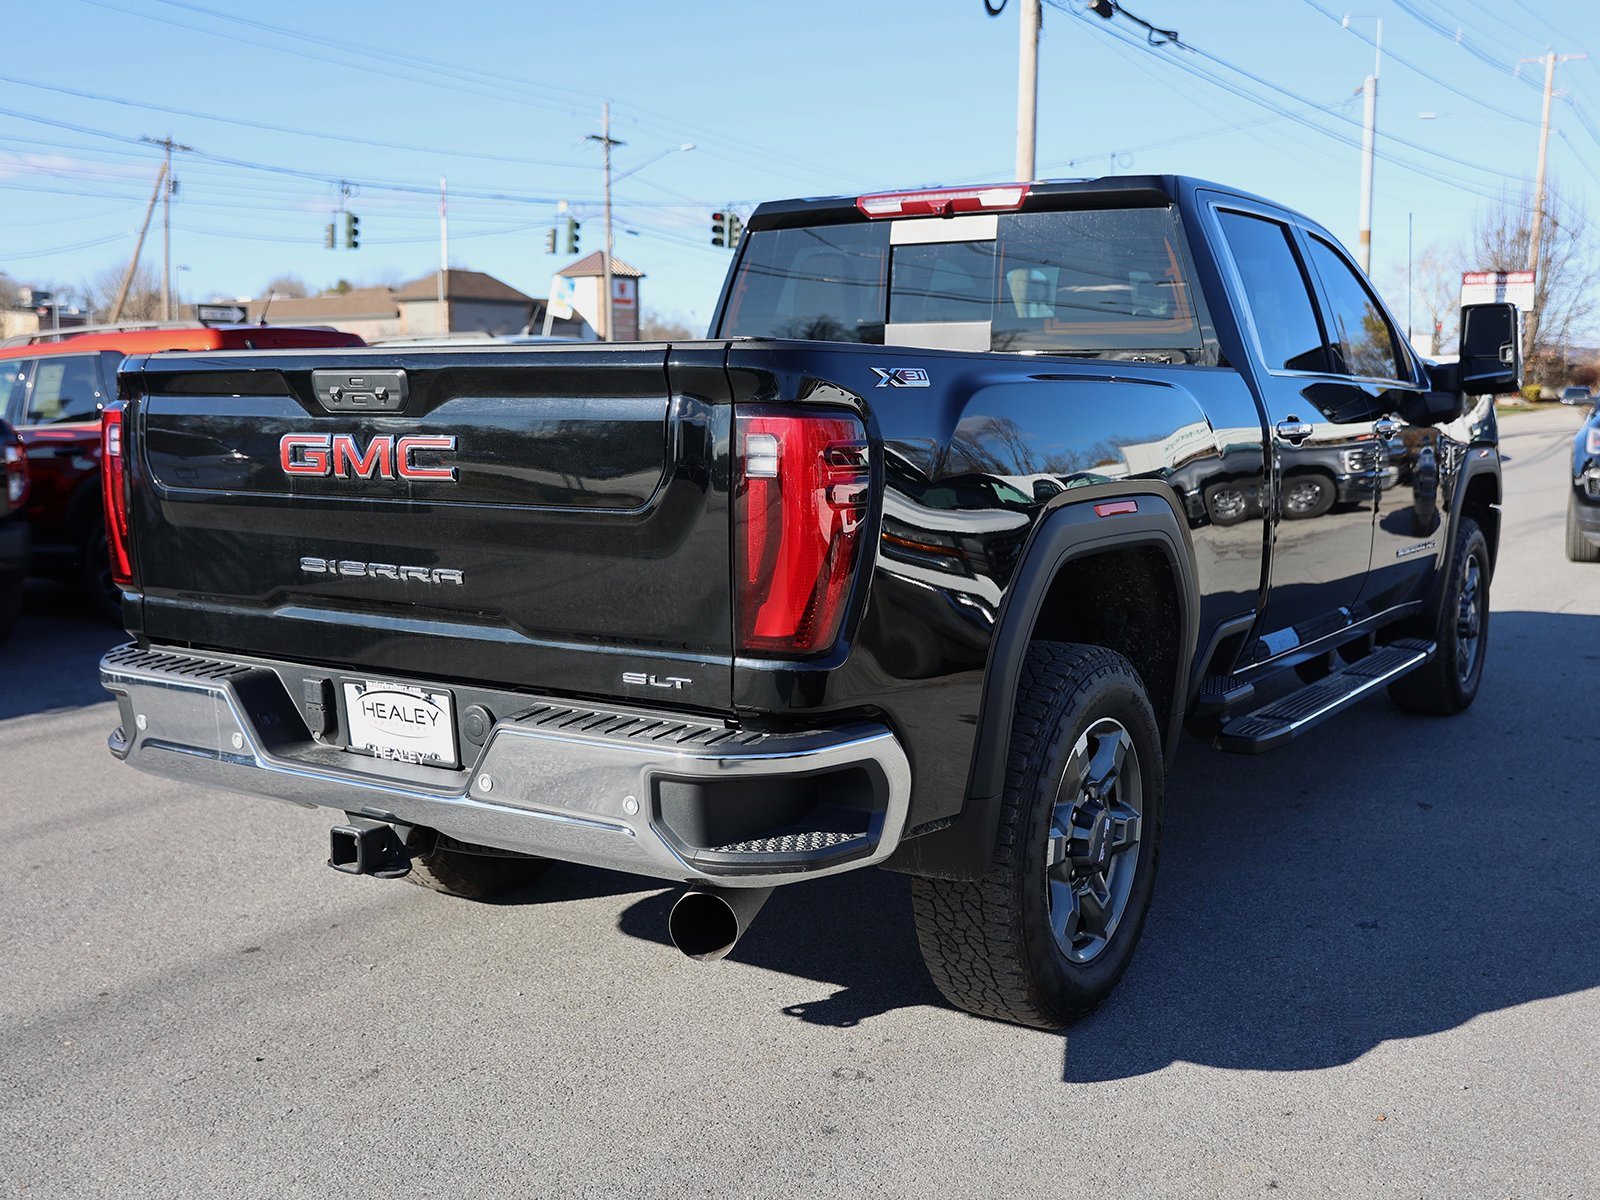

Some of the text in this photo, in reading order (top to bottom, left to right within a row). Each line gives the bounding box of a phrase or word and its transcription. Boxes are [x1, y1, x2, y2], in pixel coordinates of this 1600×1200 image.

[279, 433, 459, 483] GMC
[300, 556, 464, 585] SIERRA
[622, 672, 694, 689] SLT
[361, 701, 439, 726] HEALEY
[373, 746, 425, 764] HEALEY
